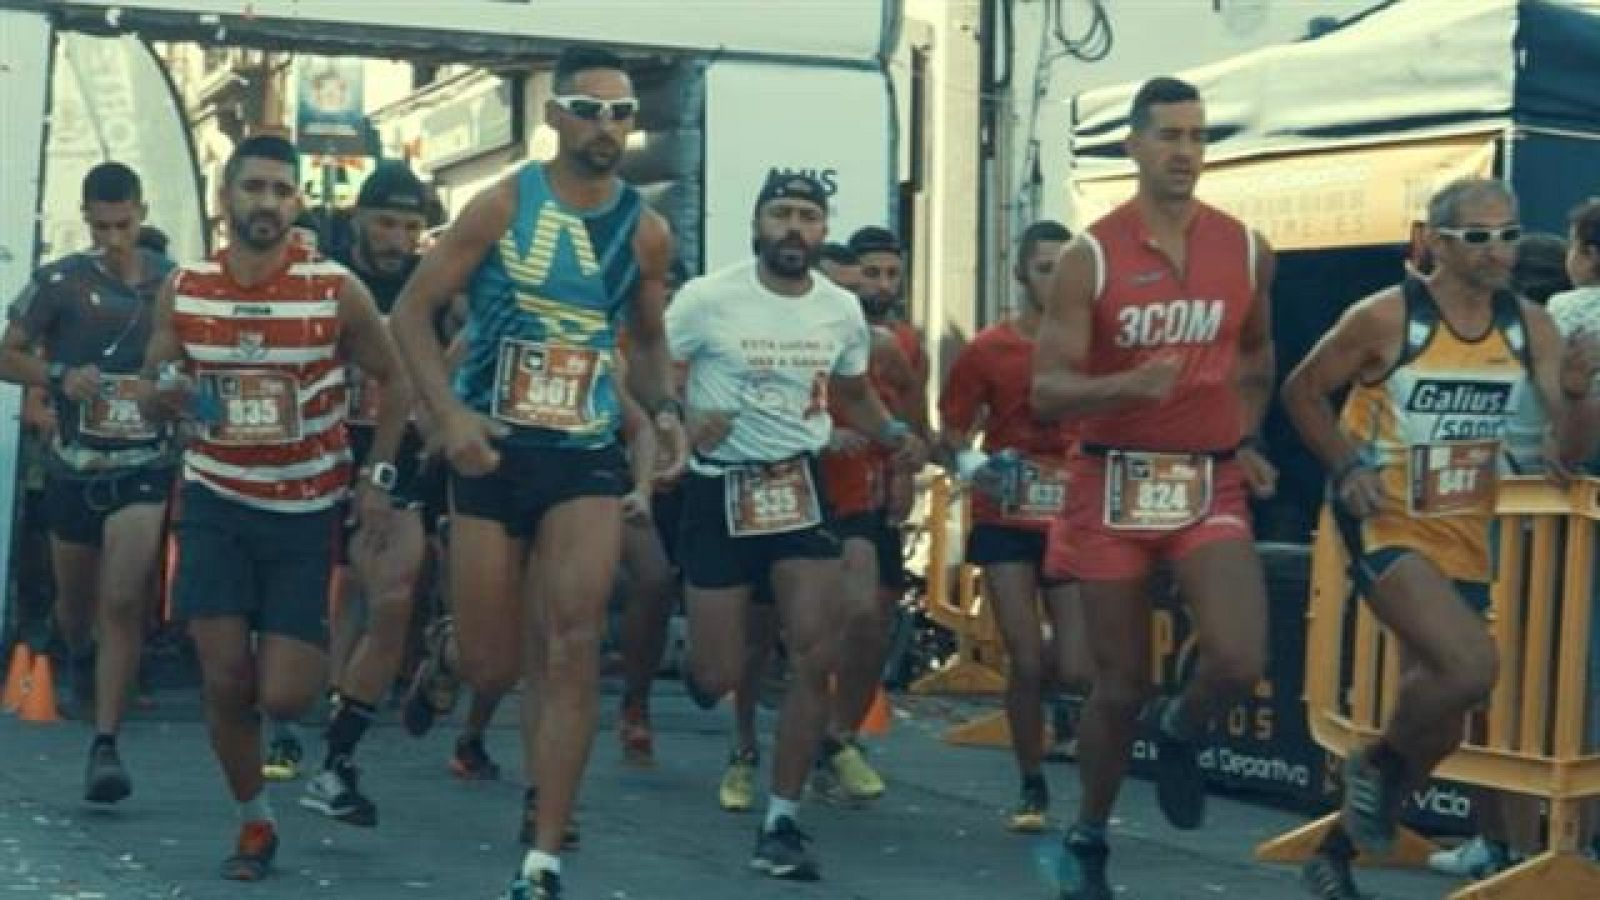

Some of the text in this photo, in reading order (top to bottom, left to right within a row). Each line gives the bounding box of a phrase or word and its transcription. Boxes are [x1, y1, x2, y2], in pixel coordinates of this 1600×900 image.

[1114, 299, 1226, 347] 3COM
[1138, 481, 1188, 509] 824
[1402, 786, 1472, 818] vicio
